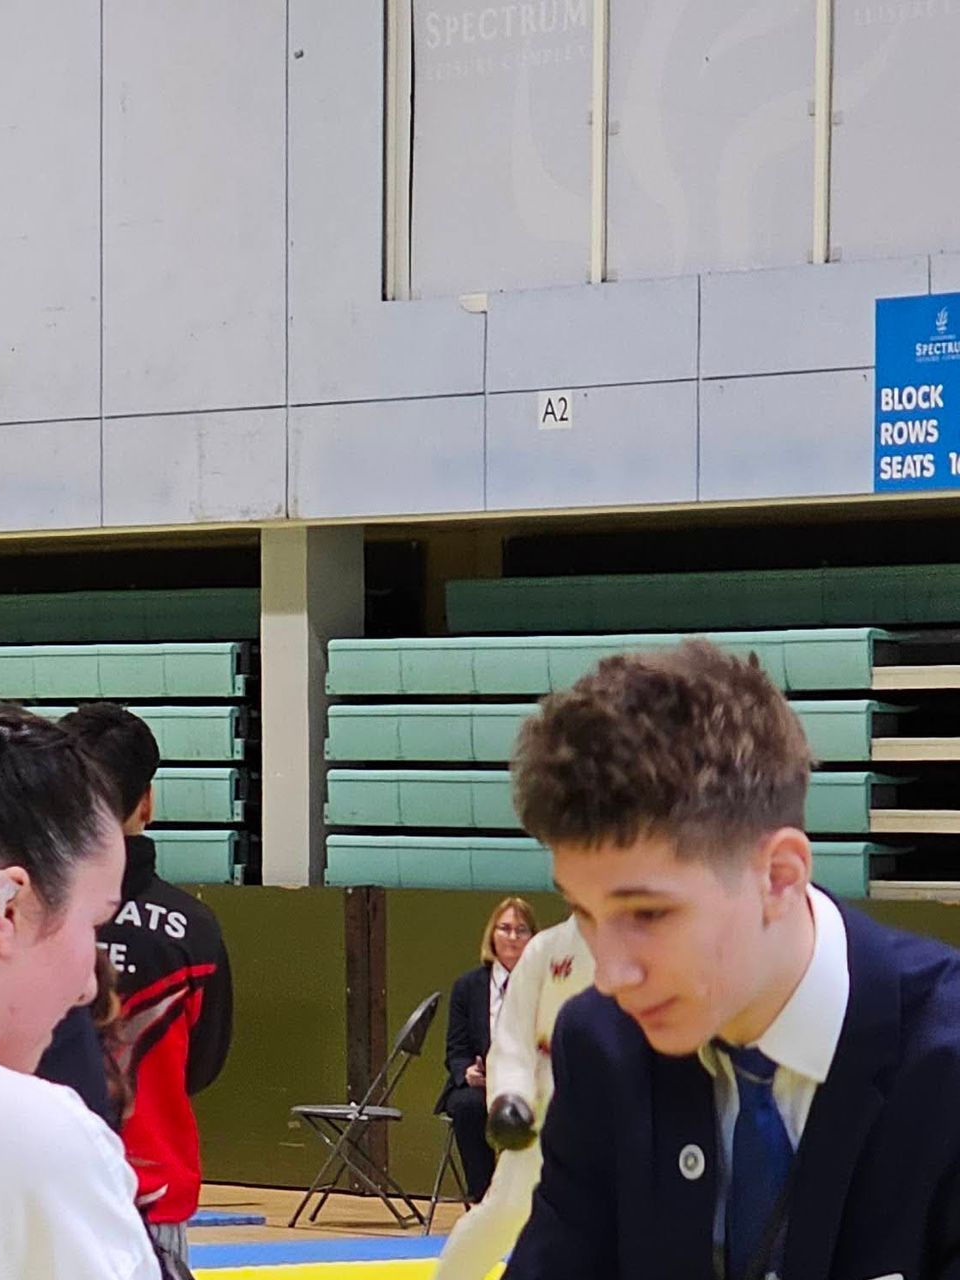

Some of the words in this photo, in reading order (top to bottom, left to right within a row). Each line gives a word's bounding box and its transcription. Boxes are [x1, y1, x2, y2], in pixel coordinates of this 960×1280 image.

[425, 0, 588, 49] SPECTRUM
[542, 396, 569, 423] A2
[881, 384, 944, 412] BLOCK
[880, 419, 939, 446] ROWS
[880, 453, 935, 481] SEATS
